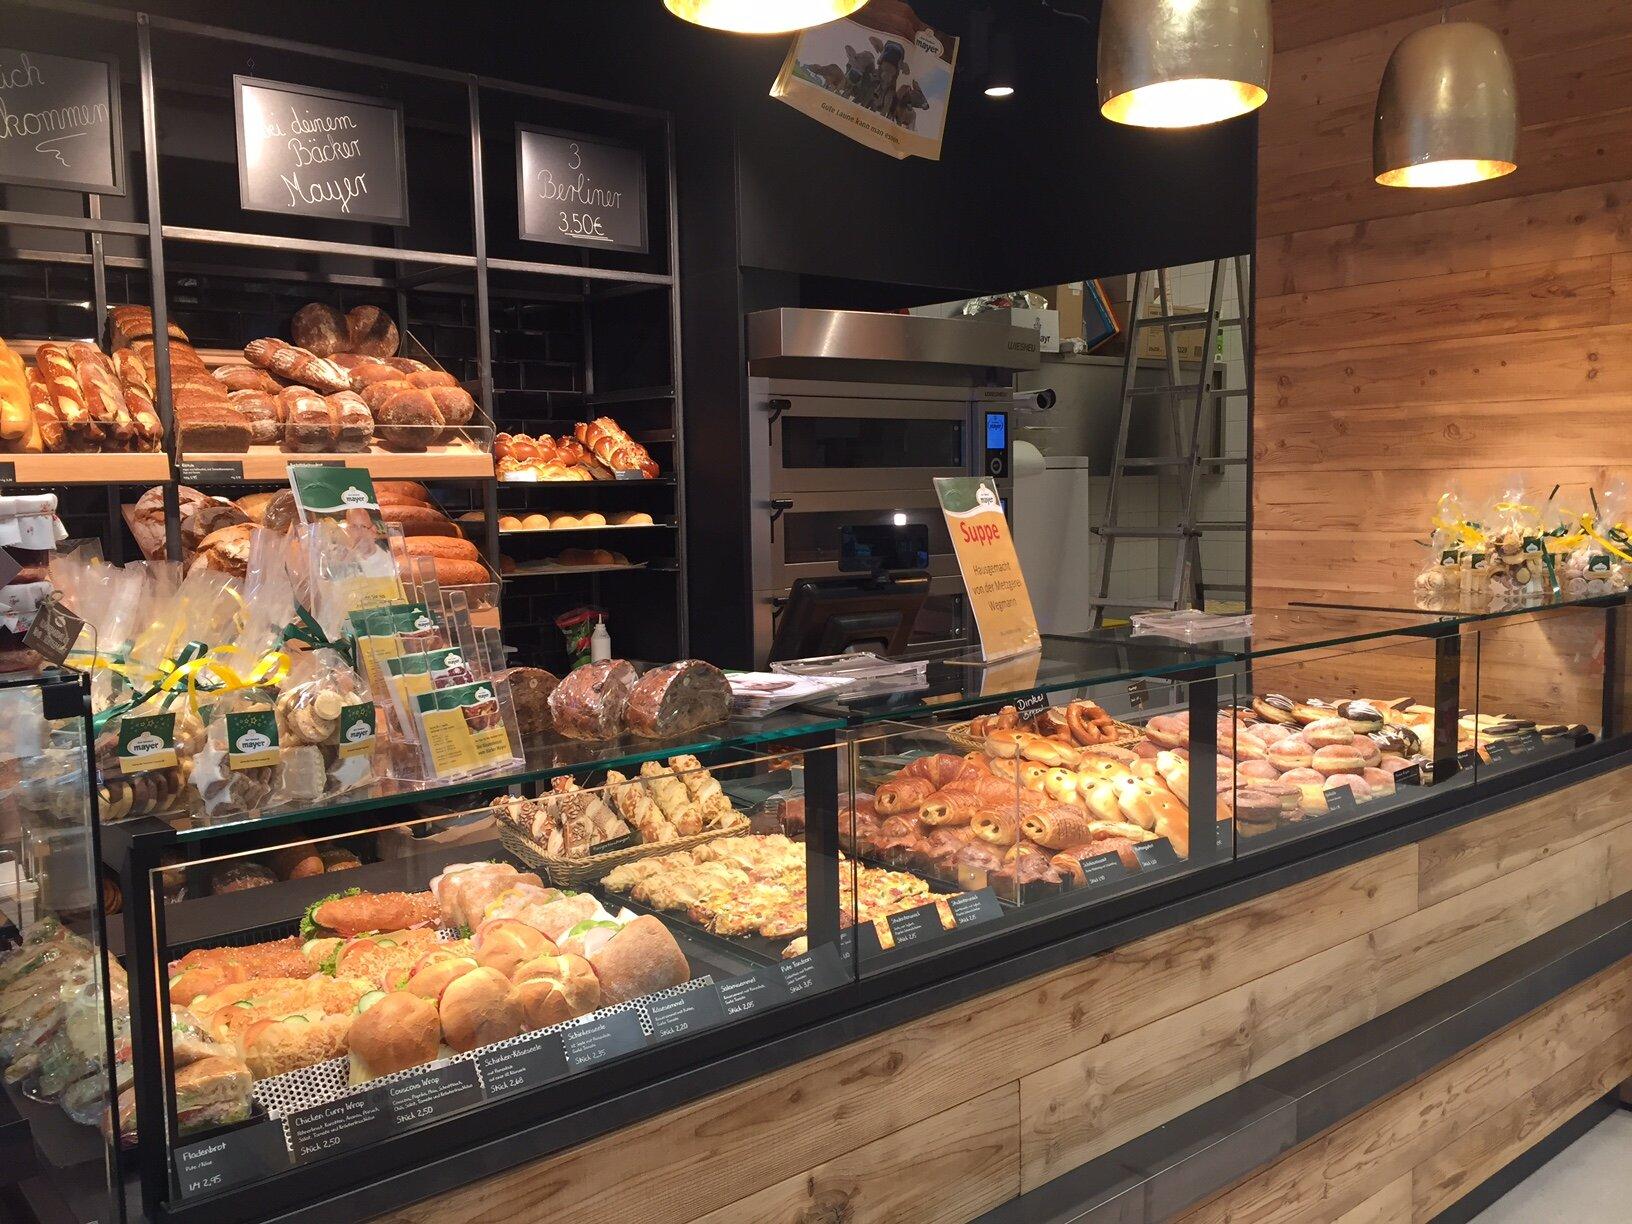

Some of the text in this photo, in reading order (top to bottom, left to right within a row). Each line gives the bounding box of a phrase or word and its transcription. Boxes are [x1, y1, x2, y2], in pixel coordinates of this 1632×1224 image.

[915, 39, 939, 54] mayer
[0, 96, 110, 138] kommen
[291, 105, 357, 135] deinem
[821, 102, 836, 114] Gute
[836, 109, 855, 123] Laune
[854, 118, 871, 131] kann
[870, 126, 884, 138] man
[287, 134, 362, 168] Bäcker
[568, 143, 581, 170] 3
[280, 171, 368, 214] Mayer
[537, 169, 622, 209] Berliner
[558, 211, 605, 236] 3.50€
[959, 520, 1001, 546] Suppe
[973, 562, 1012, 576] Hausgemacht
[972, 585, 985, 596] von
[984, 583, 996, 594] der
[988, 598, 1018, 613] Wegmann
[1016, 693, 1044, 711] Dinkel
[133, 742, 159, 752] mayer
[241, 741, 266, 750] mayer
[390, 1077, 441, 1097] Couscous Wrap
[490, 1081, 509, 1093] Stück
[294, 1101, 365, 1127] Chicken Curry Wrap
[396, 1106, 434, 1125] Stück 2,50
[182, 1142, 227, 1162] Fladenbrot
[300, 1136, 341, 1156] Stück 2,50
[202, 1173, 222, 1188] 2,95
